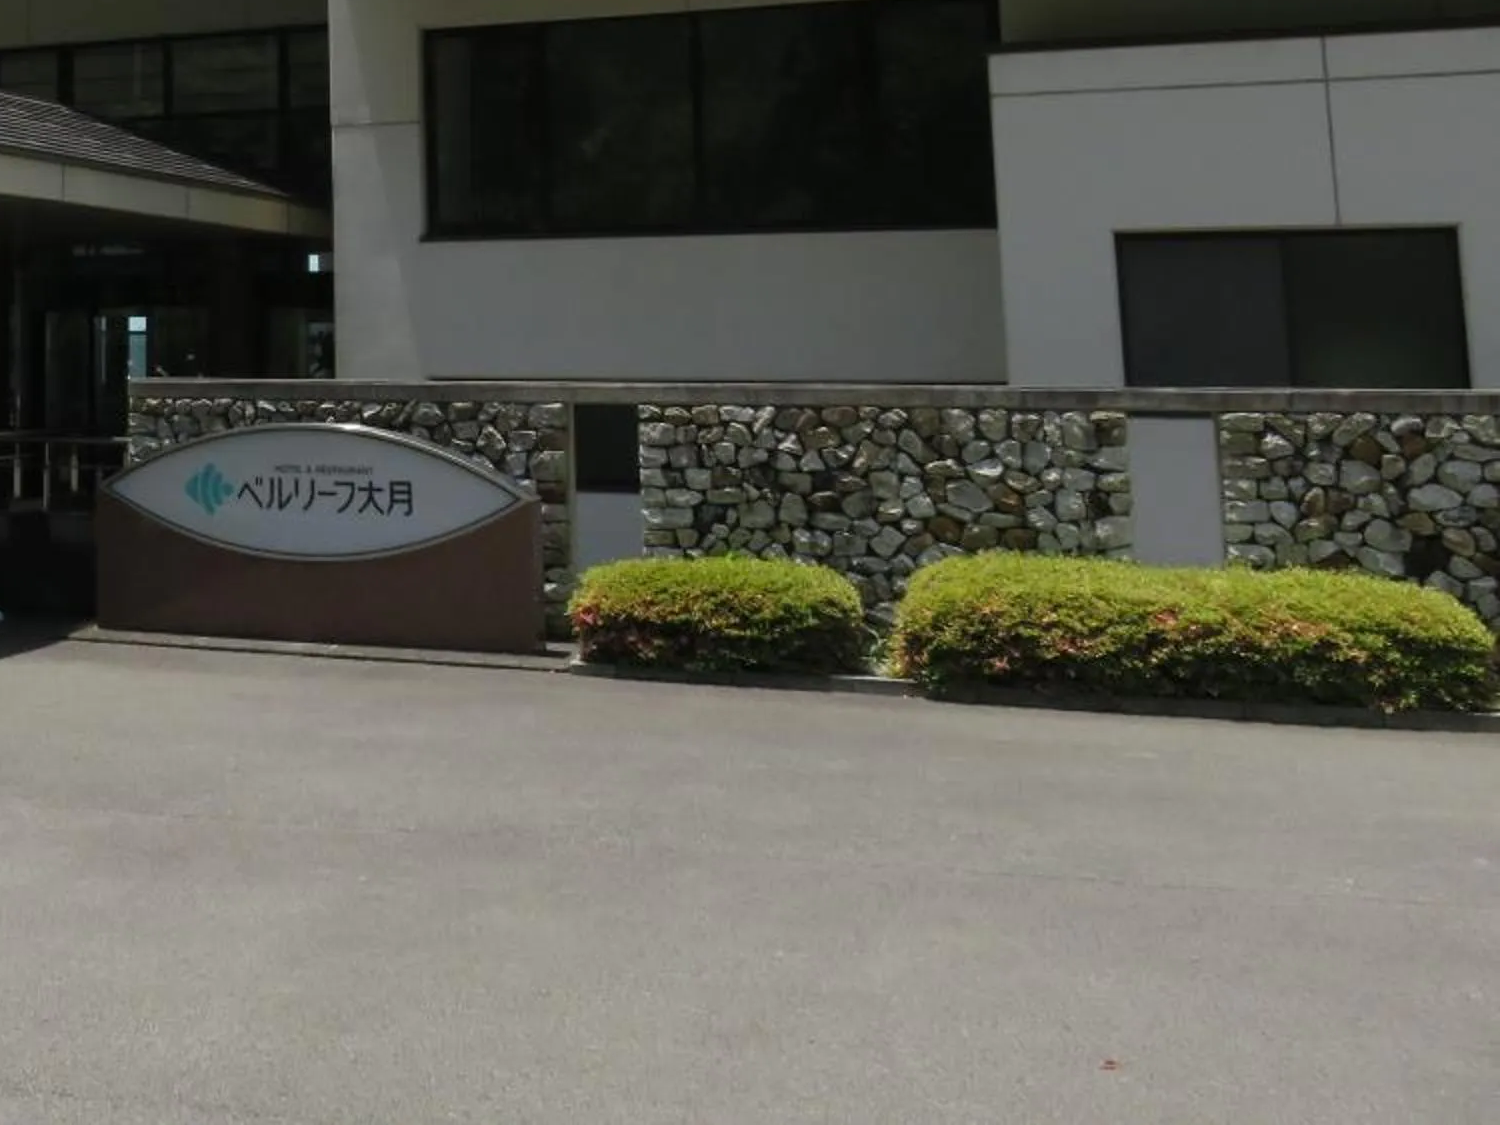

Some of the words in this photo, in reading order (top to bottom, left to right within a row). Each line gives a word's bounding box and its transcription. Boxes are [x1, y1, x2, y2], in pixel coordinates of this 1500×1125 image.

[238, 476, 414, 516] ベルリーフ大月
